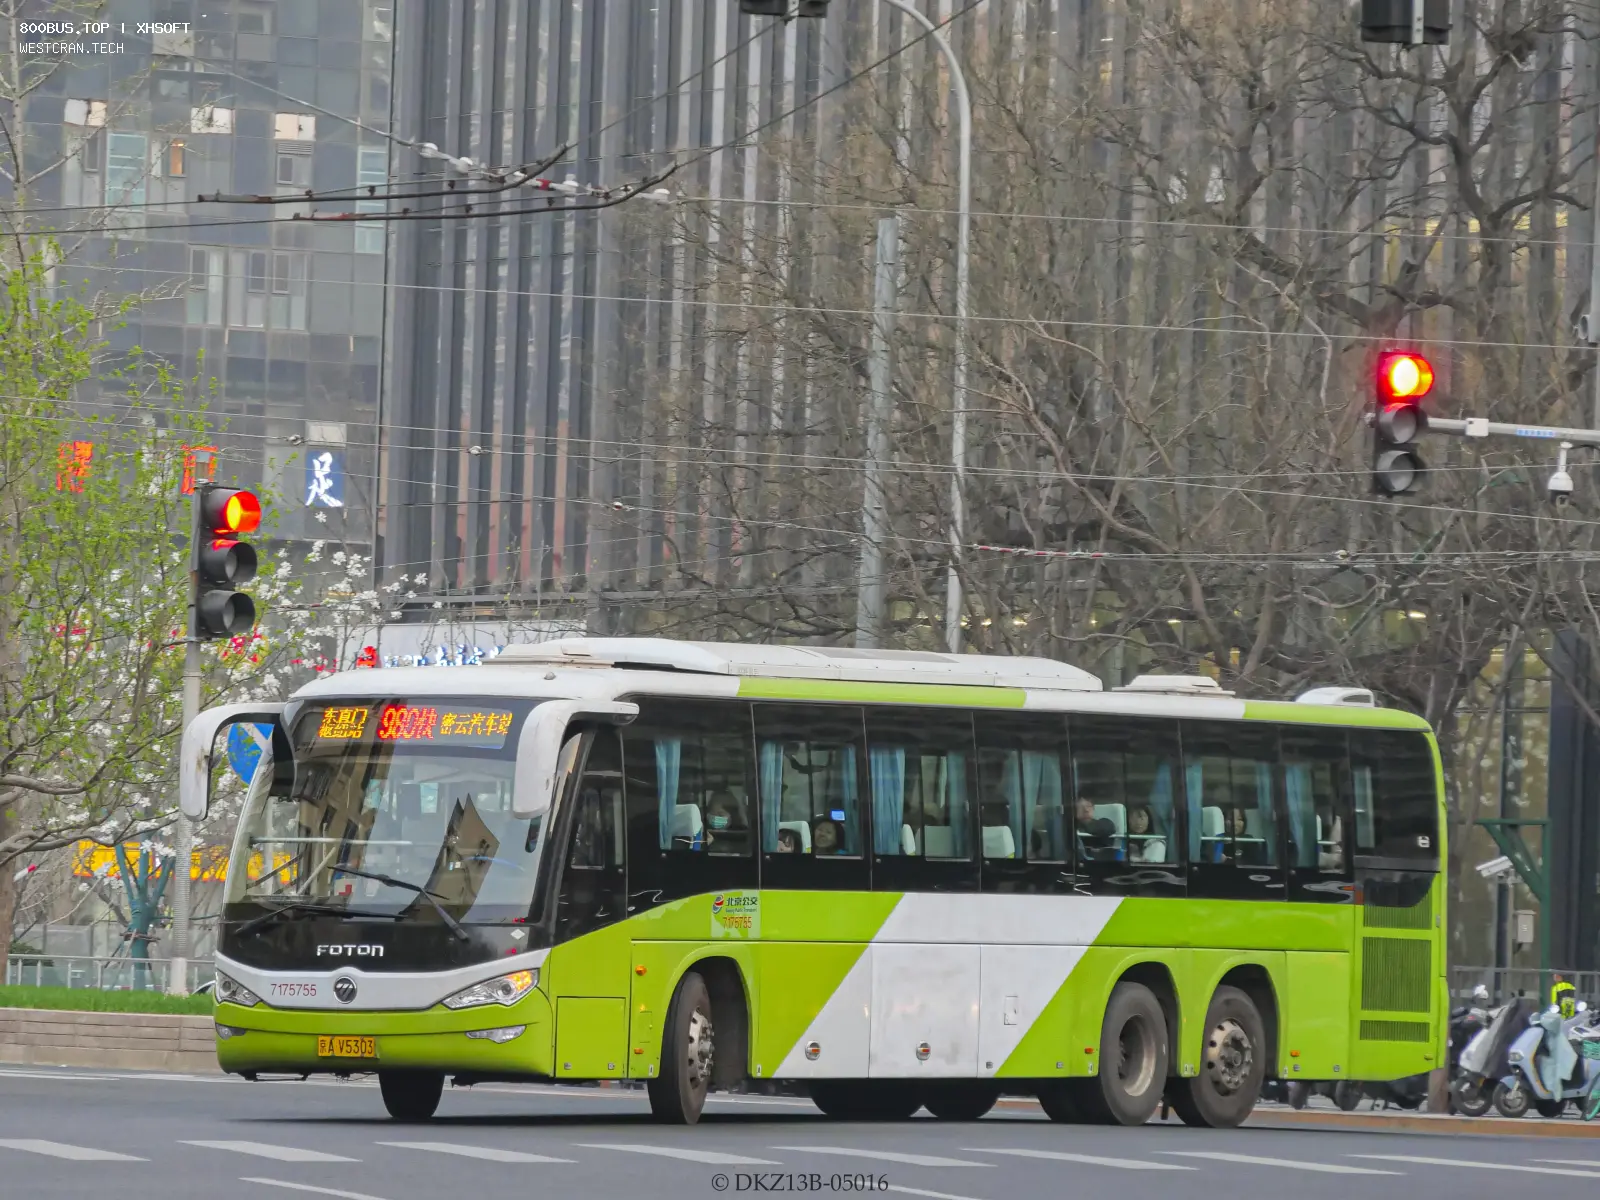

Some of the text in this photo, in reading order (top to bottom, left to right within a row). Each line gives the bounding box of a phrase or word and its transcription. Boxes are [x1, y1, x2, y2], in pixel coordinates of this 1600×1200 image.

[305, 451, 344, 507] 足
[322, 707, 368, 725] 东直门
[378, 705, 437, 740] 980快
[440, 712, 513, 736] 密云汽车站
[726, 897, 757, 906] 北京公交
[723, 916, 752, 928] 7175755
[316, 944, 384, 957] FOTON
[270, 983, 317, 997] 7175755
